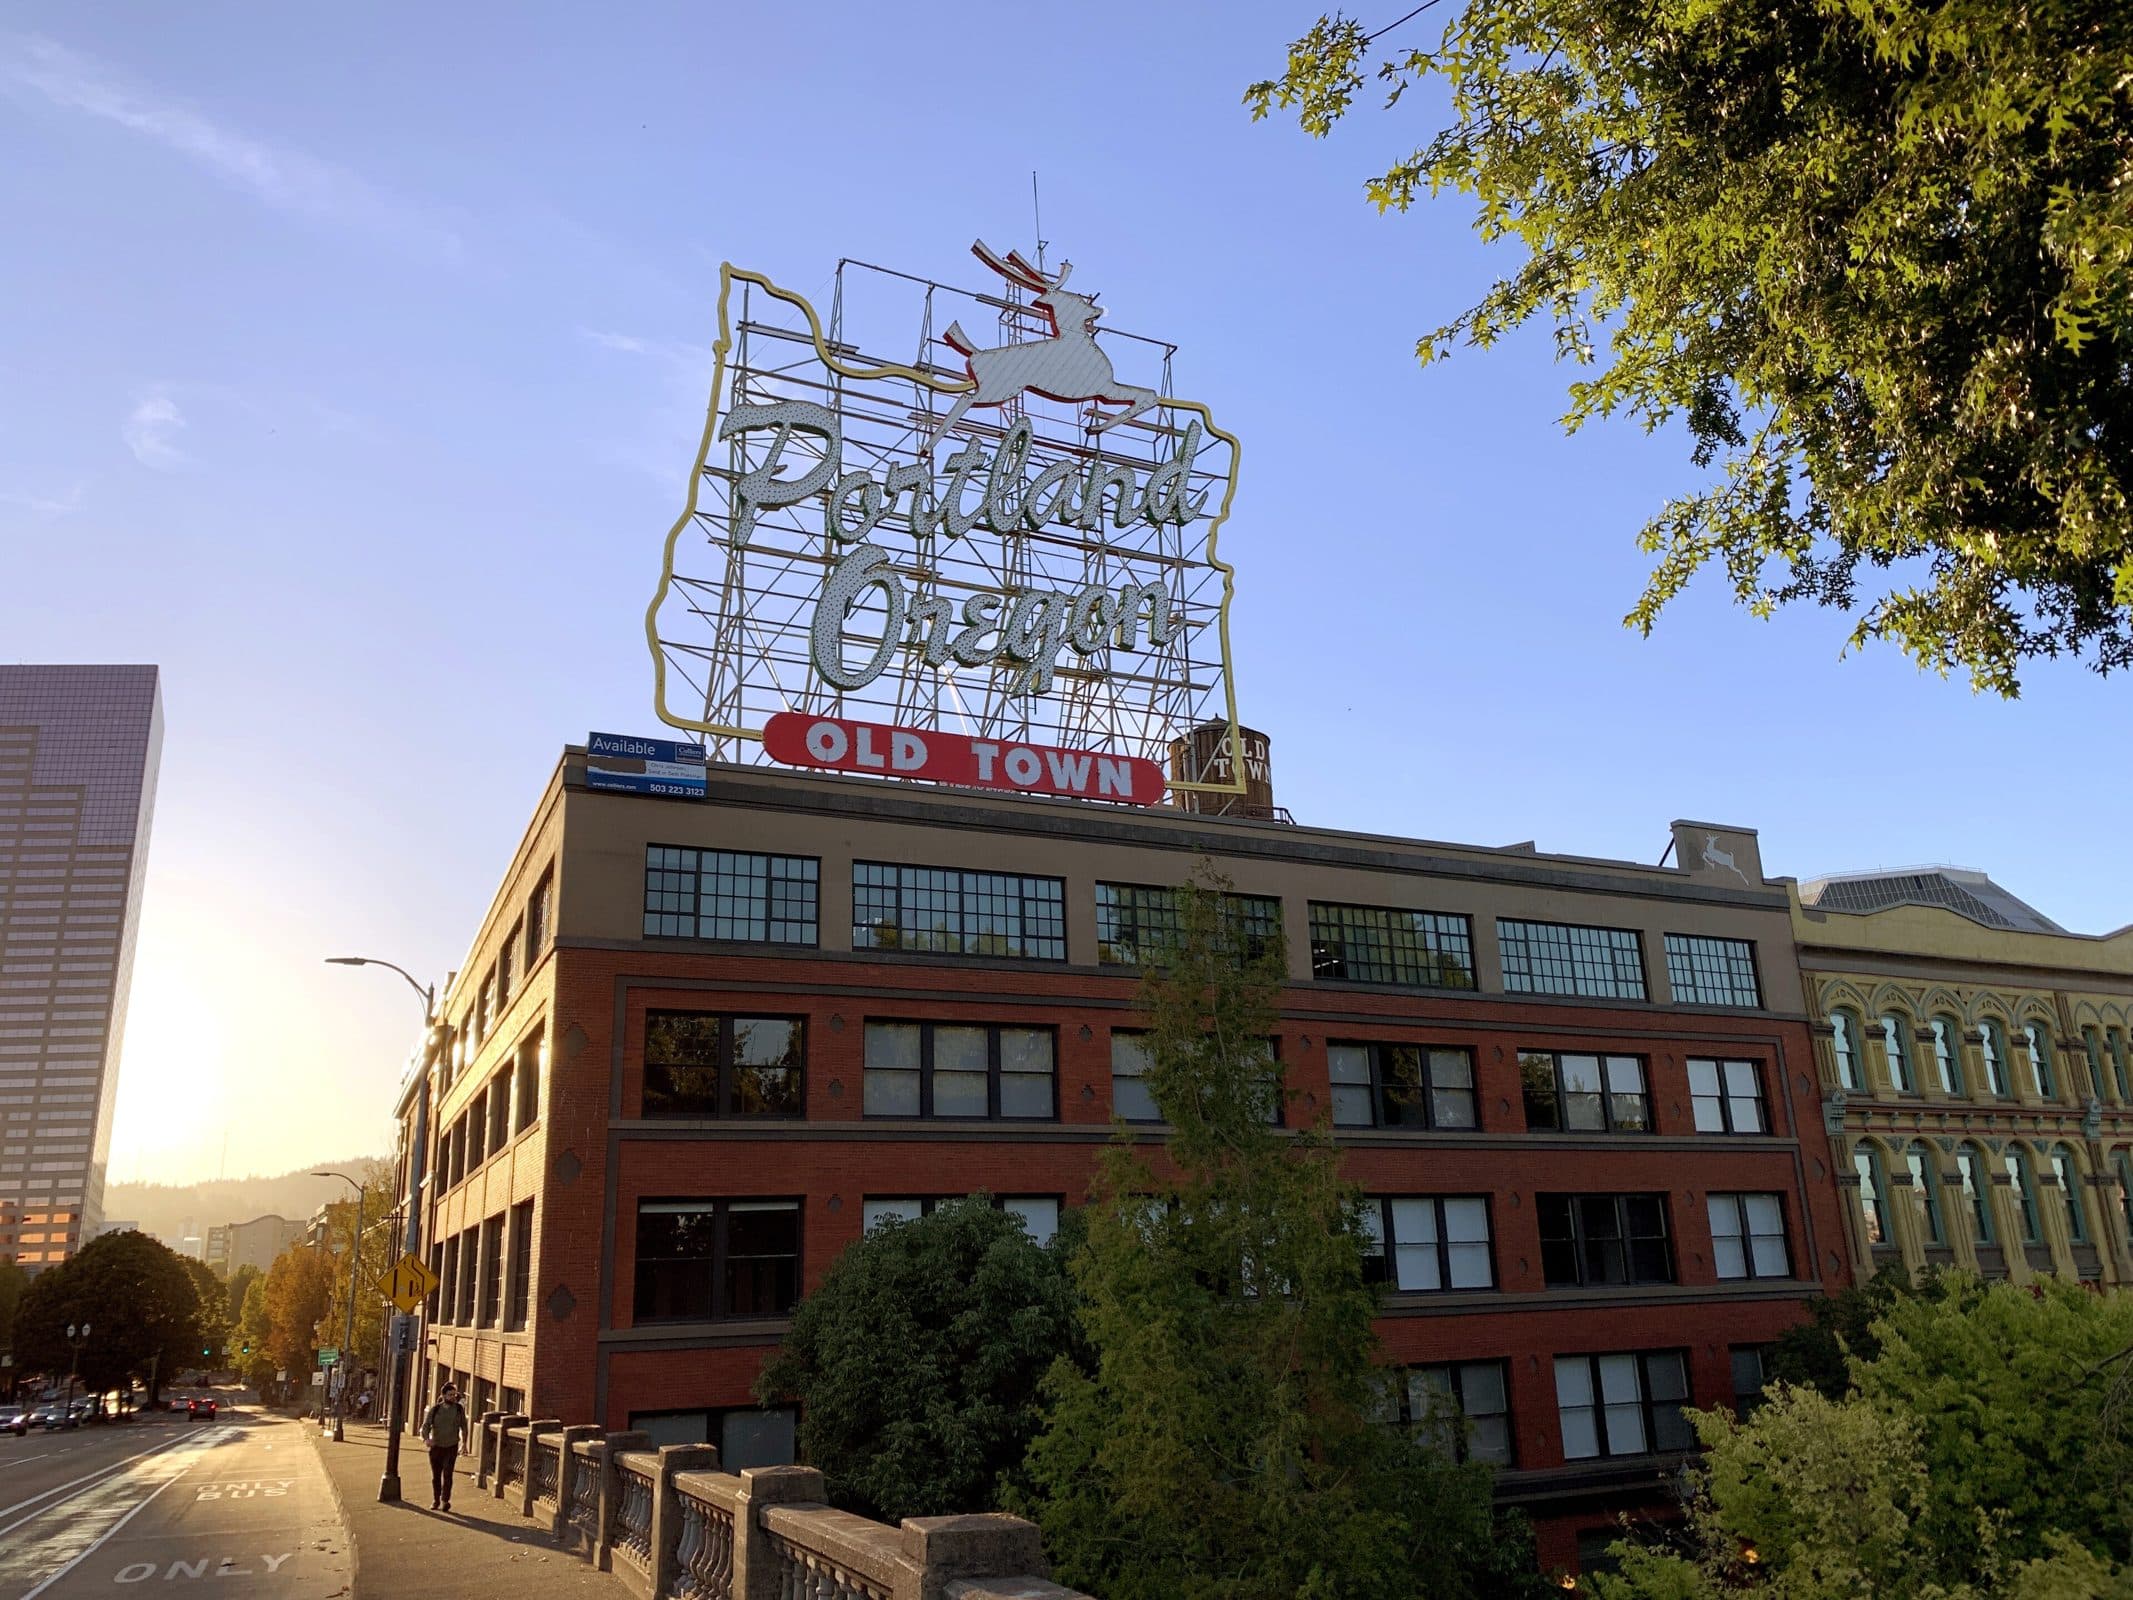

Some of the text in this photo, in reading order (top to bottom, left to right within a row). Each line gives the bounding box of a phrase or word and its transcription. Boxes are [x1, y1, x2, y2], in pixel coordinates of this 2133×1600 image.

[718, 399, 1209, 548] Portland
[809, 543, 1188, 699] Oregon
[593, 736, 656, 756] Available
[806, 721, 1134, 797] OLD TOWN
[650, 783, 705, 797] 503 223 3123
[196, 1488, 288, 1501] BUS
[197, 1480, 295, 1492] ONLY
[113, 1552, 293, 1583] ONLY
